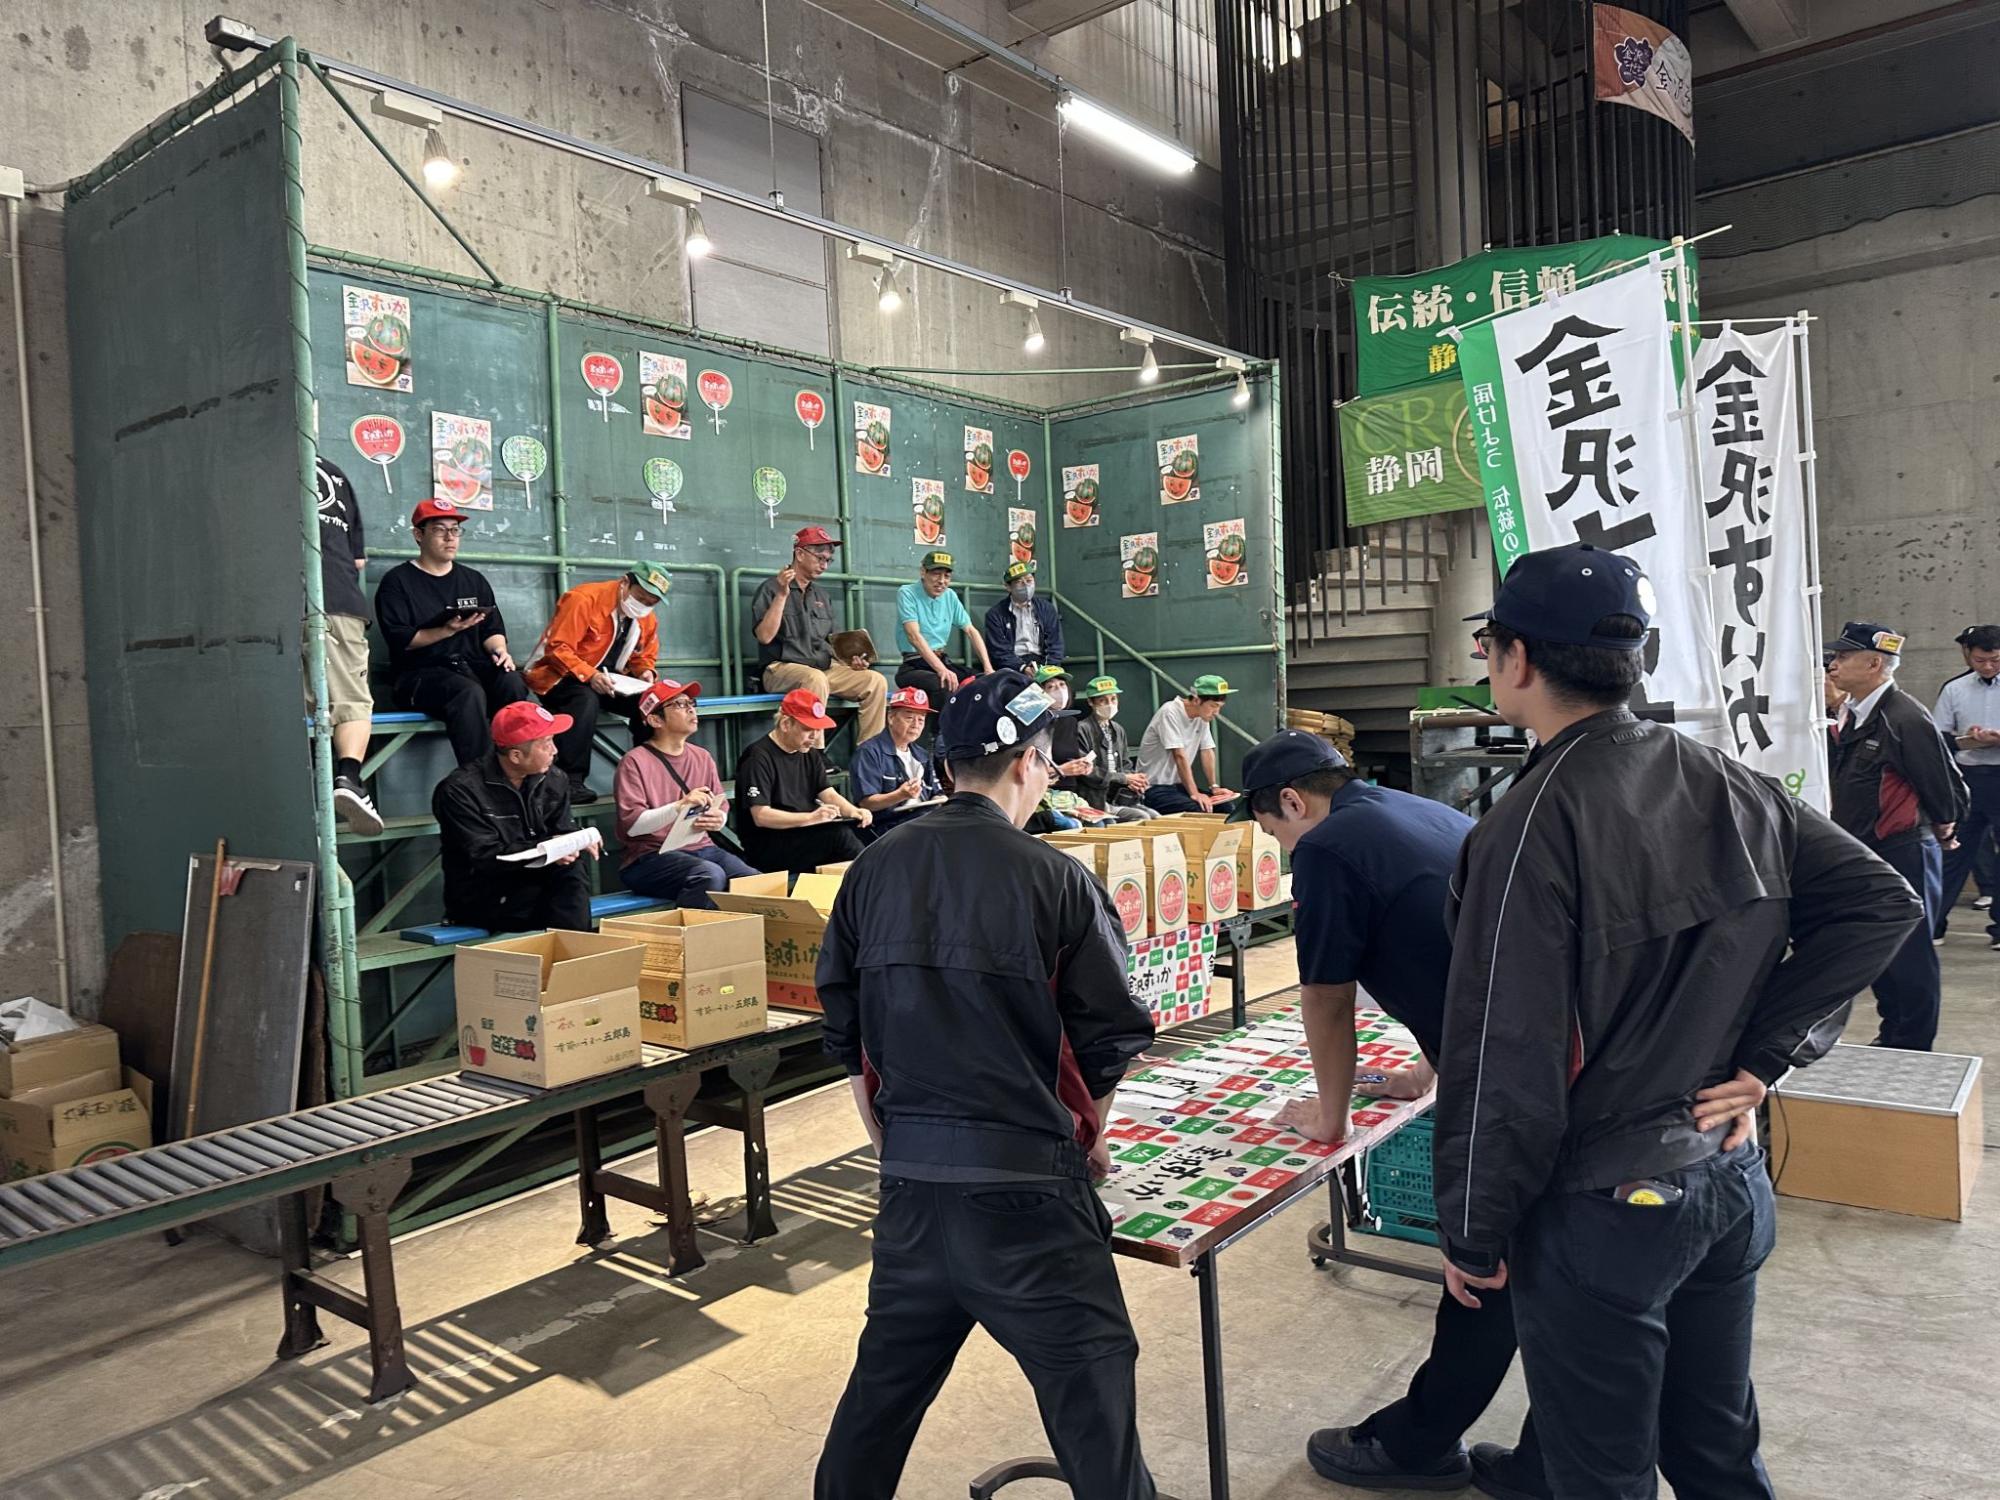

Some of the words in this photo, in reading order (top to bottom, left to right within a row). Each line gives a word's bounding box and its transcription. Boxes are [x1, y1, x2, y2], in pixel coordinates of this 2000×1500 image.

[346, 291, 407, 315] 金沢すいか
[435, 416, 489, 438] 金沢すいか
[1365, 446, 1444, 496] 静岡
[1125, 1145, 1234, 1201] 金沢すいか
